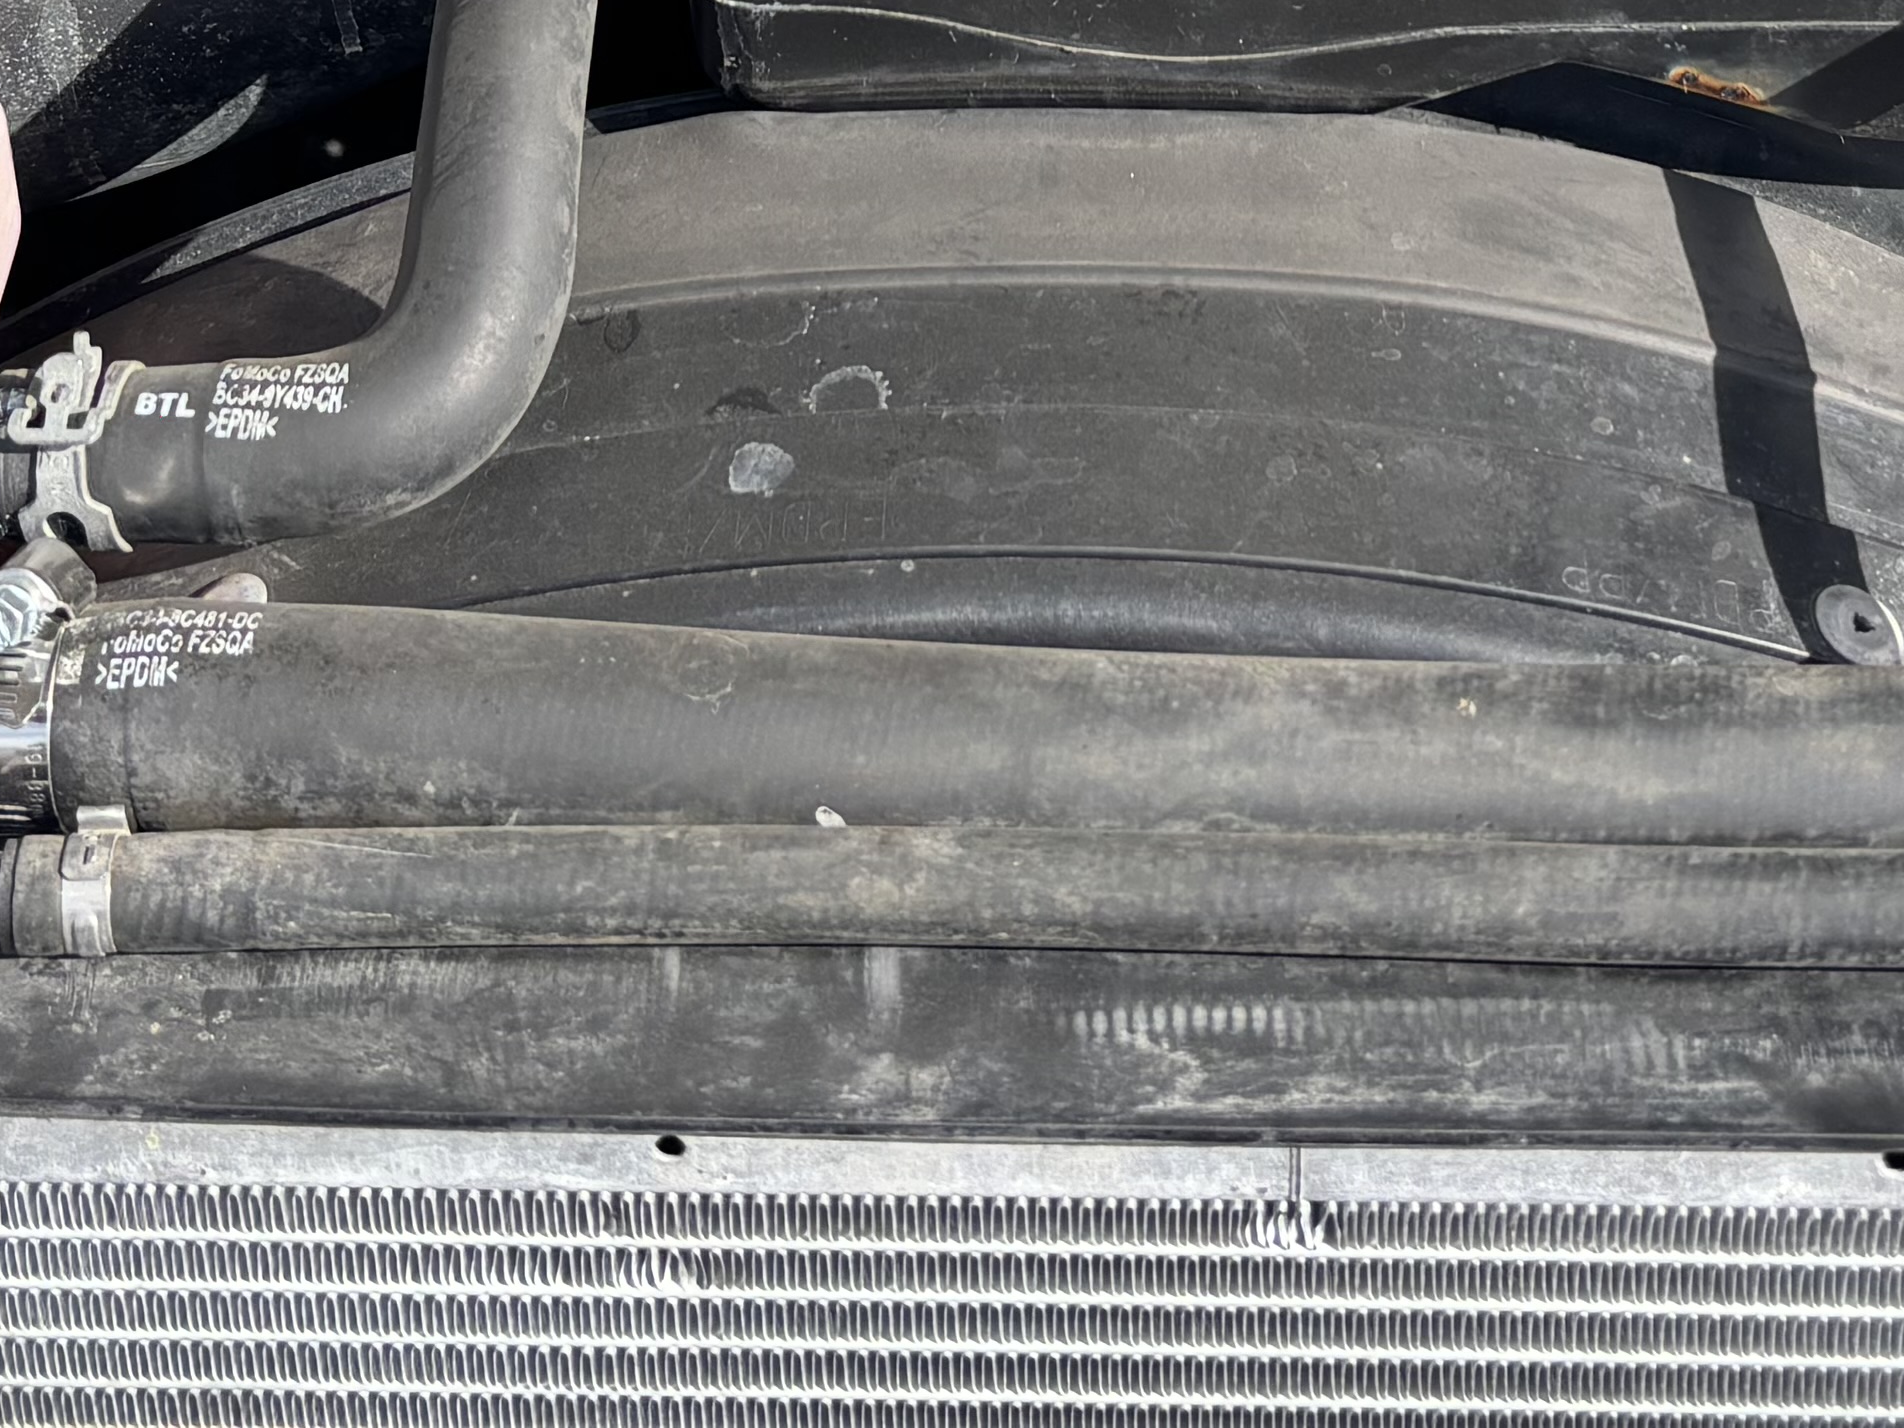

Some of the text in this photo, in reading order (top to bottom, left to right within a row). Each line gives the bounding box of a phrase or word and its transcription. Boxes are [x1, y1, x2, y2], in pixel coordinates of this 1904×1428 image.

[293, 362, 350, 385] FZSQA
[133, 392, 196, 418] BTL
[186, 629, 256, 656] FZSQA
